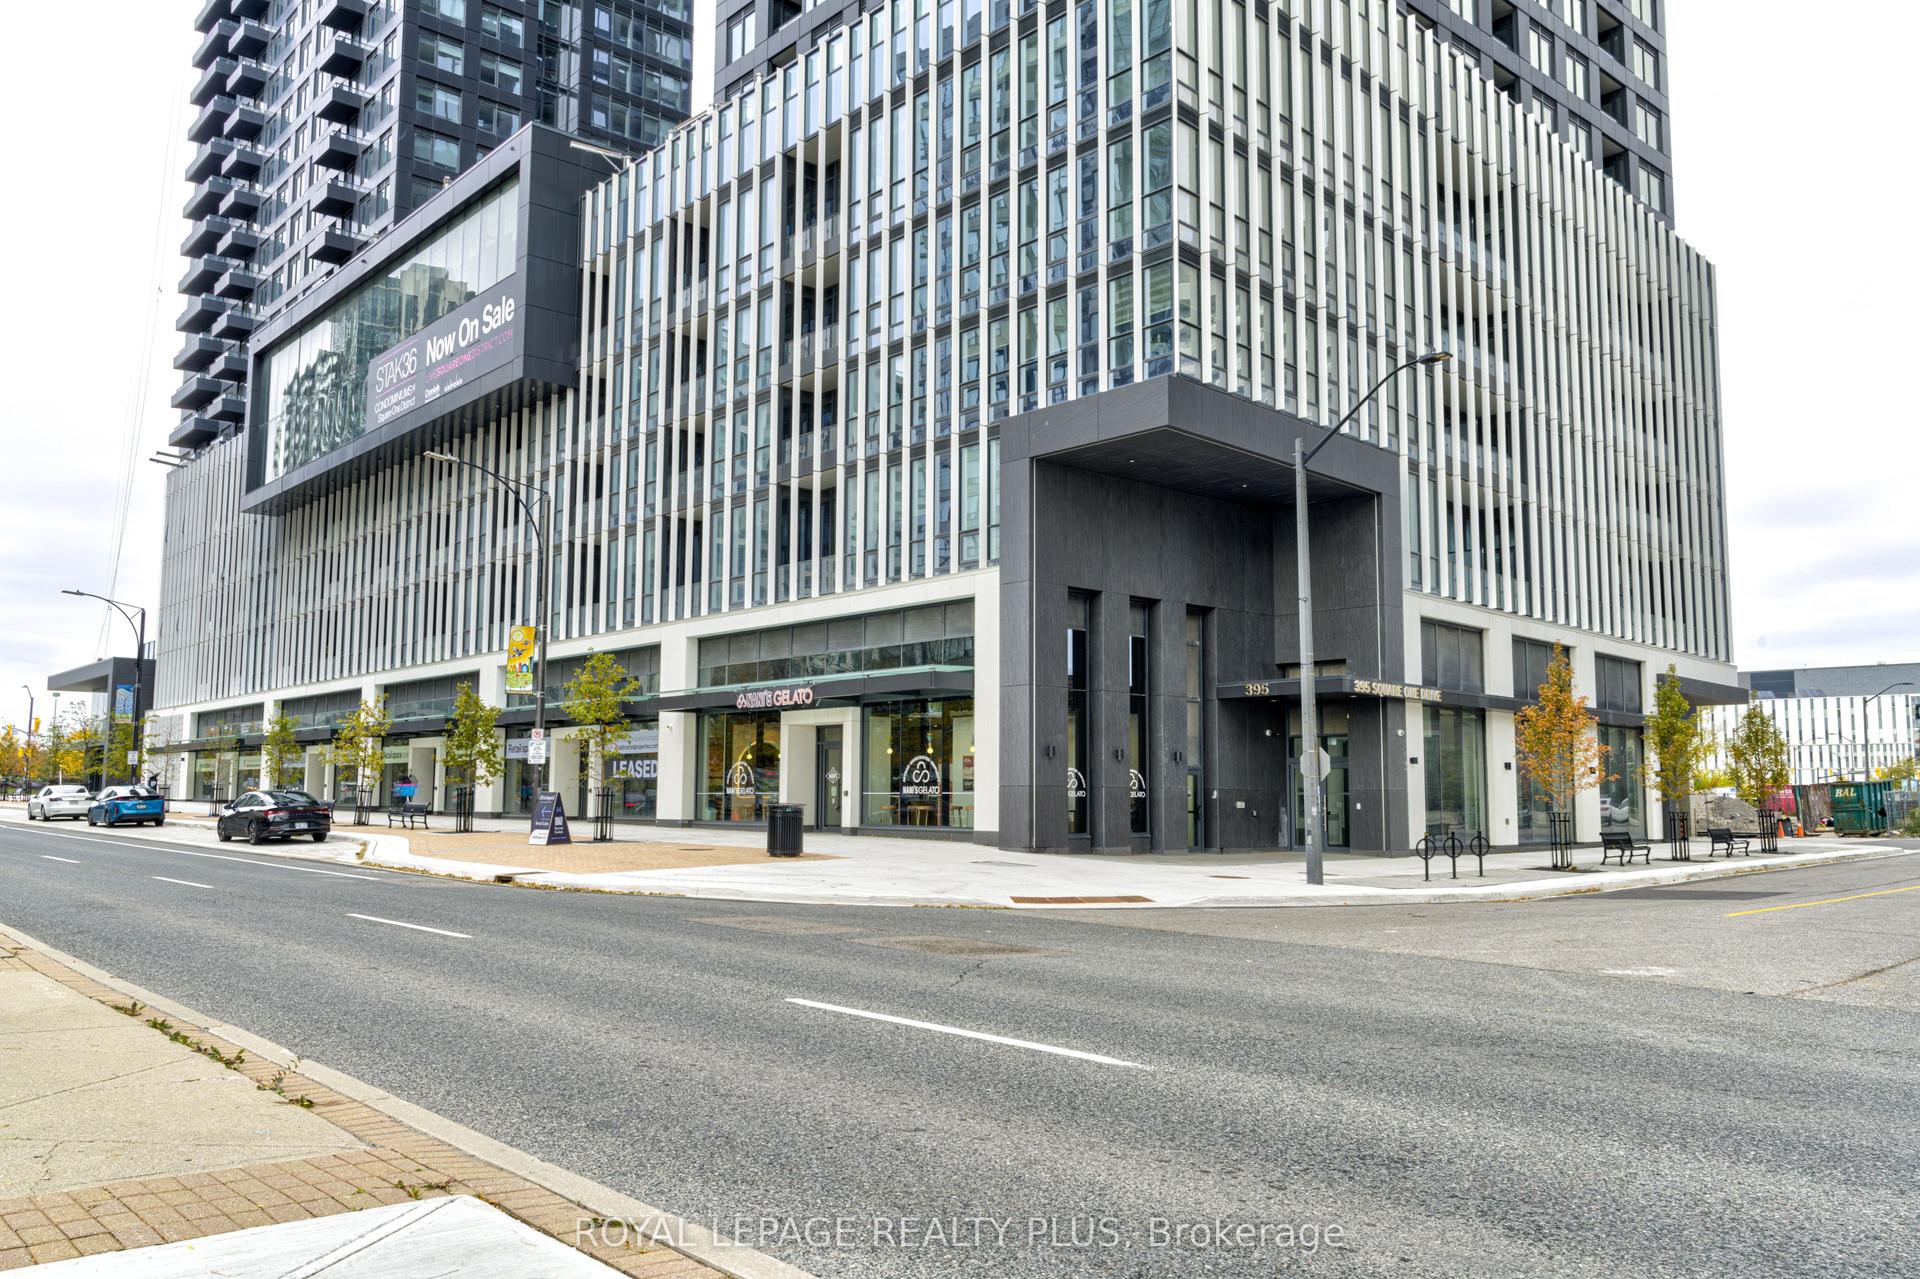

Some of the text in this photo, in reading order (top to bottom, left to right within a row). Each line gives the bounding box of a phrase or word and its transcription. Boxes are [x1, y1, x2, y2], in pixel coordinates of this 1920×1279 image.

[425, 295, 515, 367] Now On Sale
[375, 347, 418, 393] STAK36
[374, 384, 413, 414] CONDOMINIUMS
[773, 687, 813, 706] GELATO
[1244, 683, 1270, 696] 395
[1354, 680, 1442, 702] 395 SQUARE ONE DRIVE
[612, 759, 658, 778] LEASED
[918, 786, 940, 795] GELATO
[1067, 790, 1086, 798] GELATO
[1834, 787, 1857, 798] BAL
